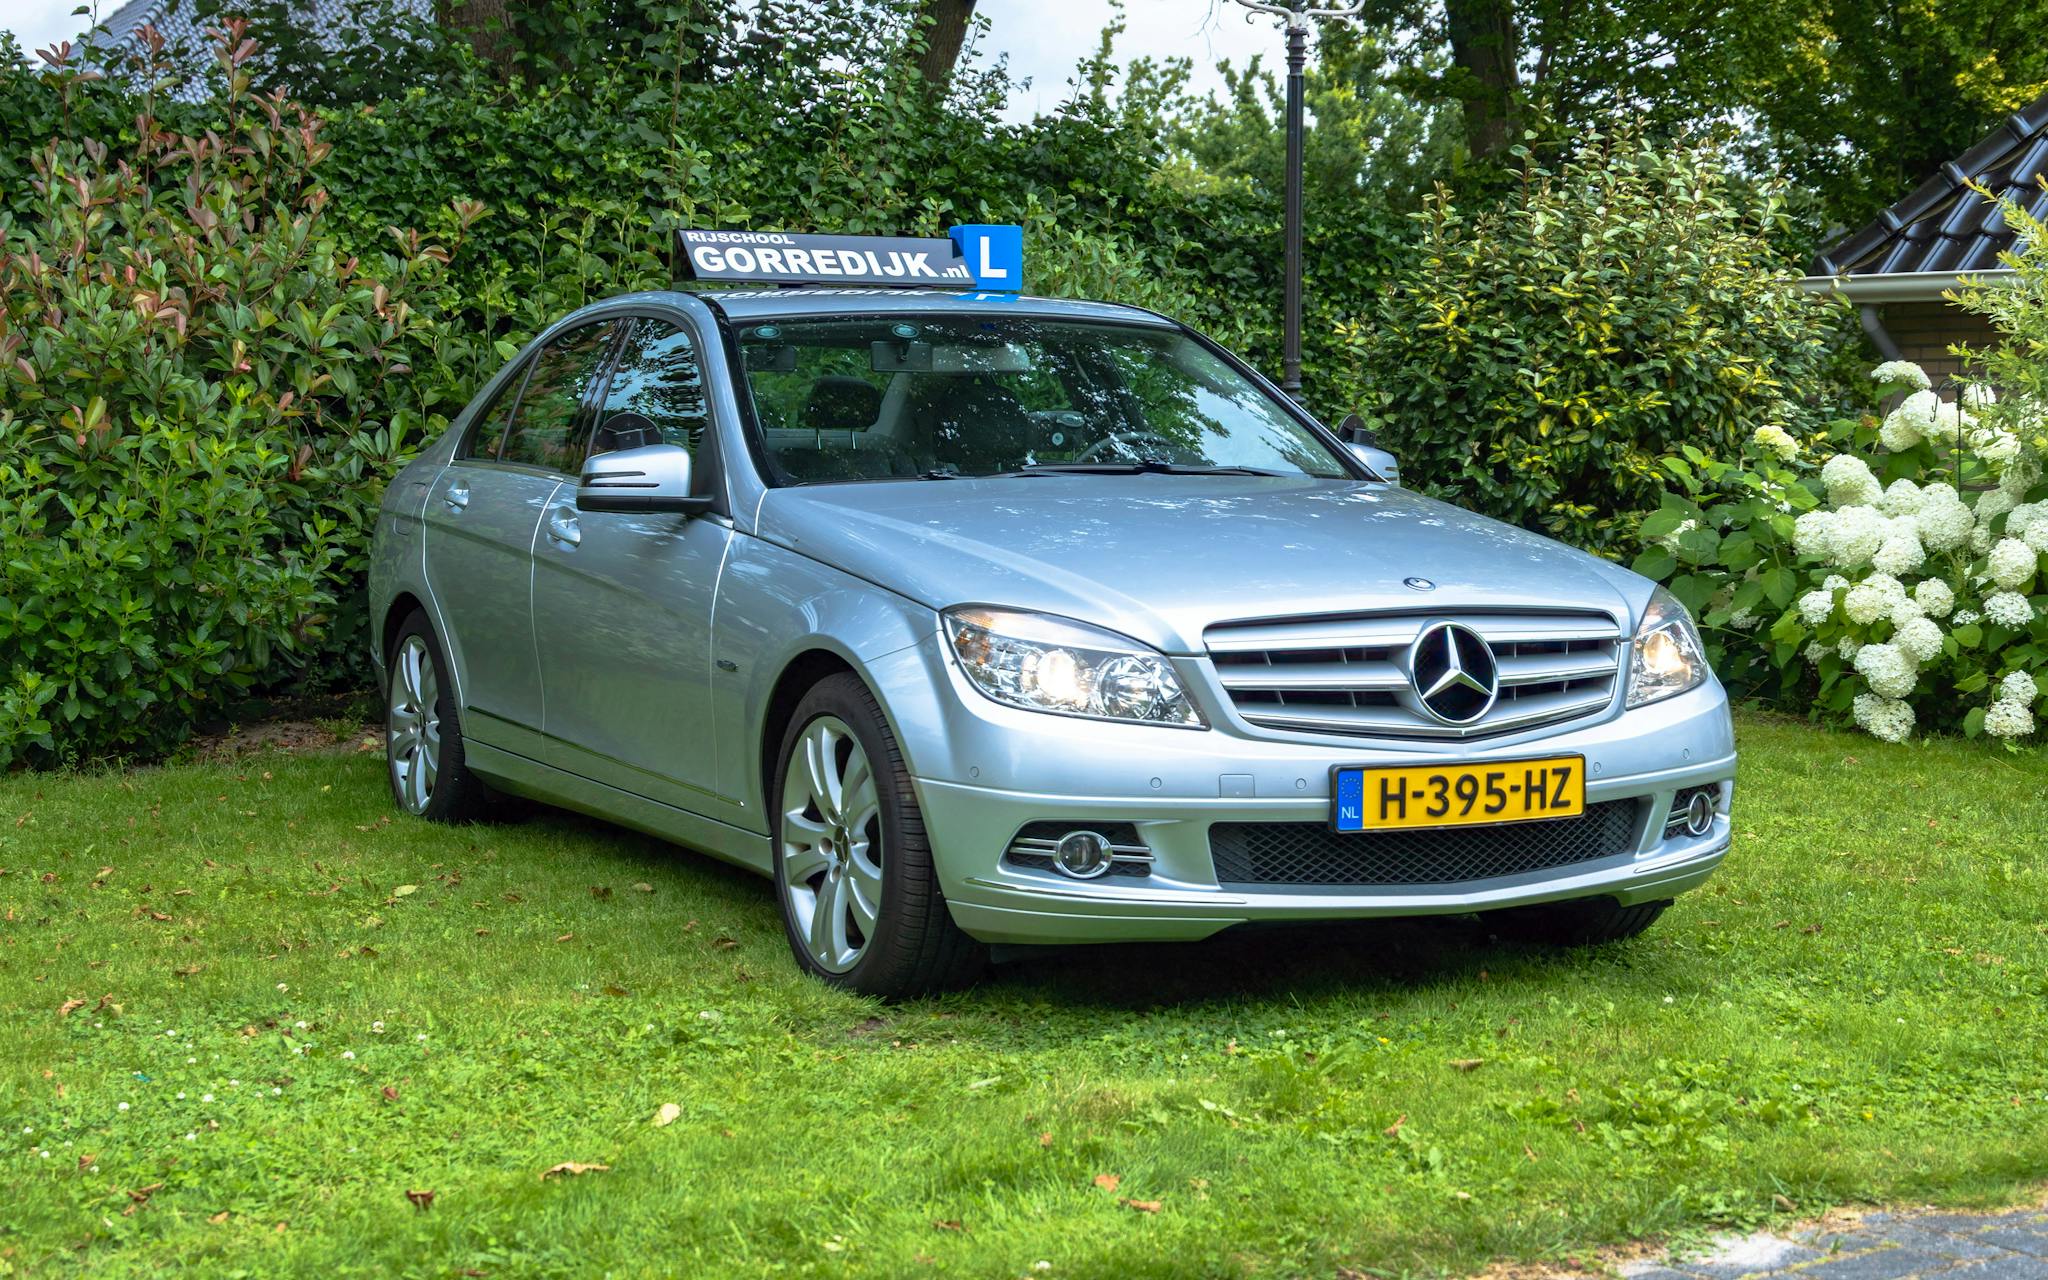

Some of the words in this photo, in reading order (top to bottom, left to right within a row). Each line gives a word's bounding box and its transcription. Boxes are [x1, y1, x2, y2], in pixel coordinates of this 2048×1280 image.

[687, 232, 795, 245] RIJSCHOOL
[979, 236, 1008, 279] L
[1380, 766, 1572, 820] H-395-HZ
[1341, 806, 1360, 819] NL
